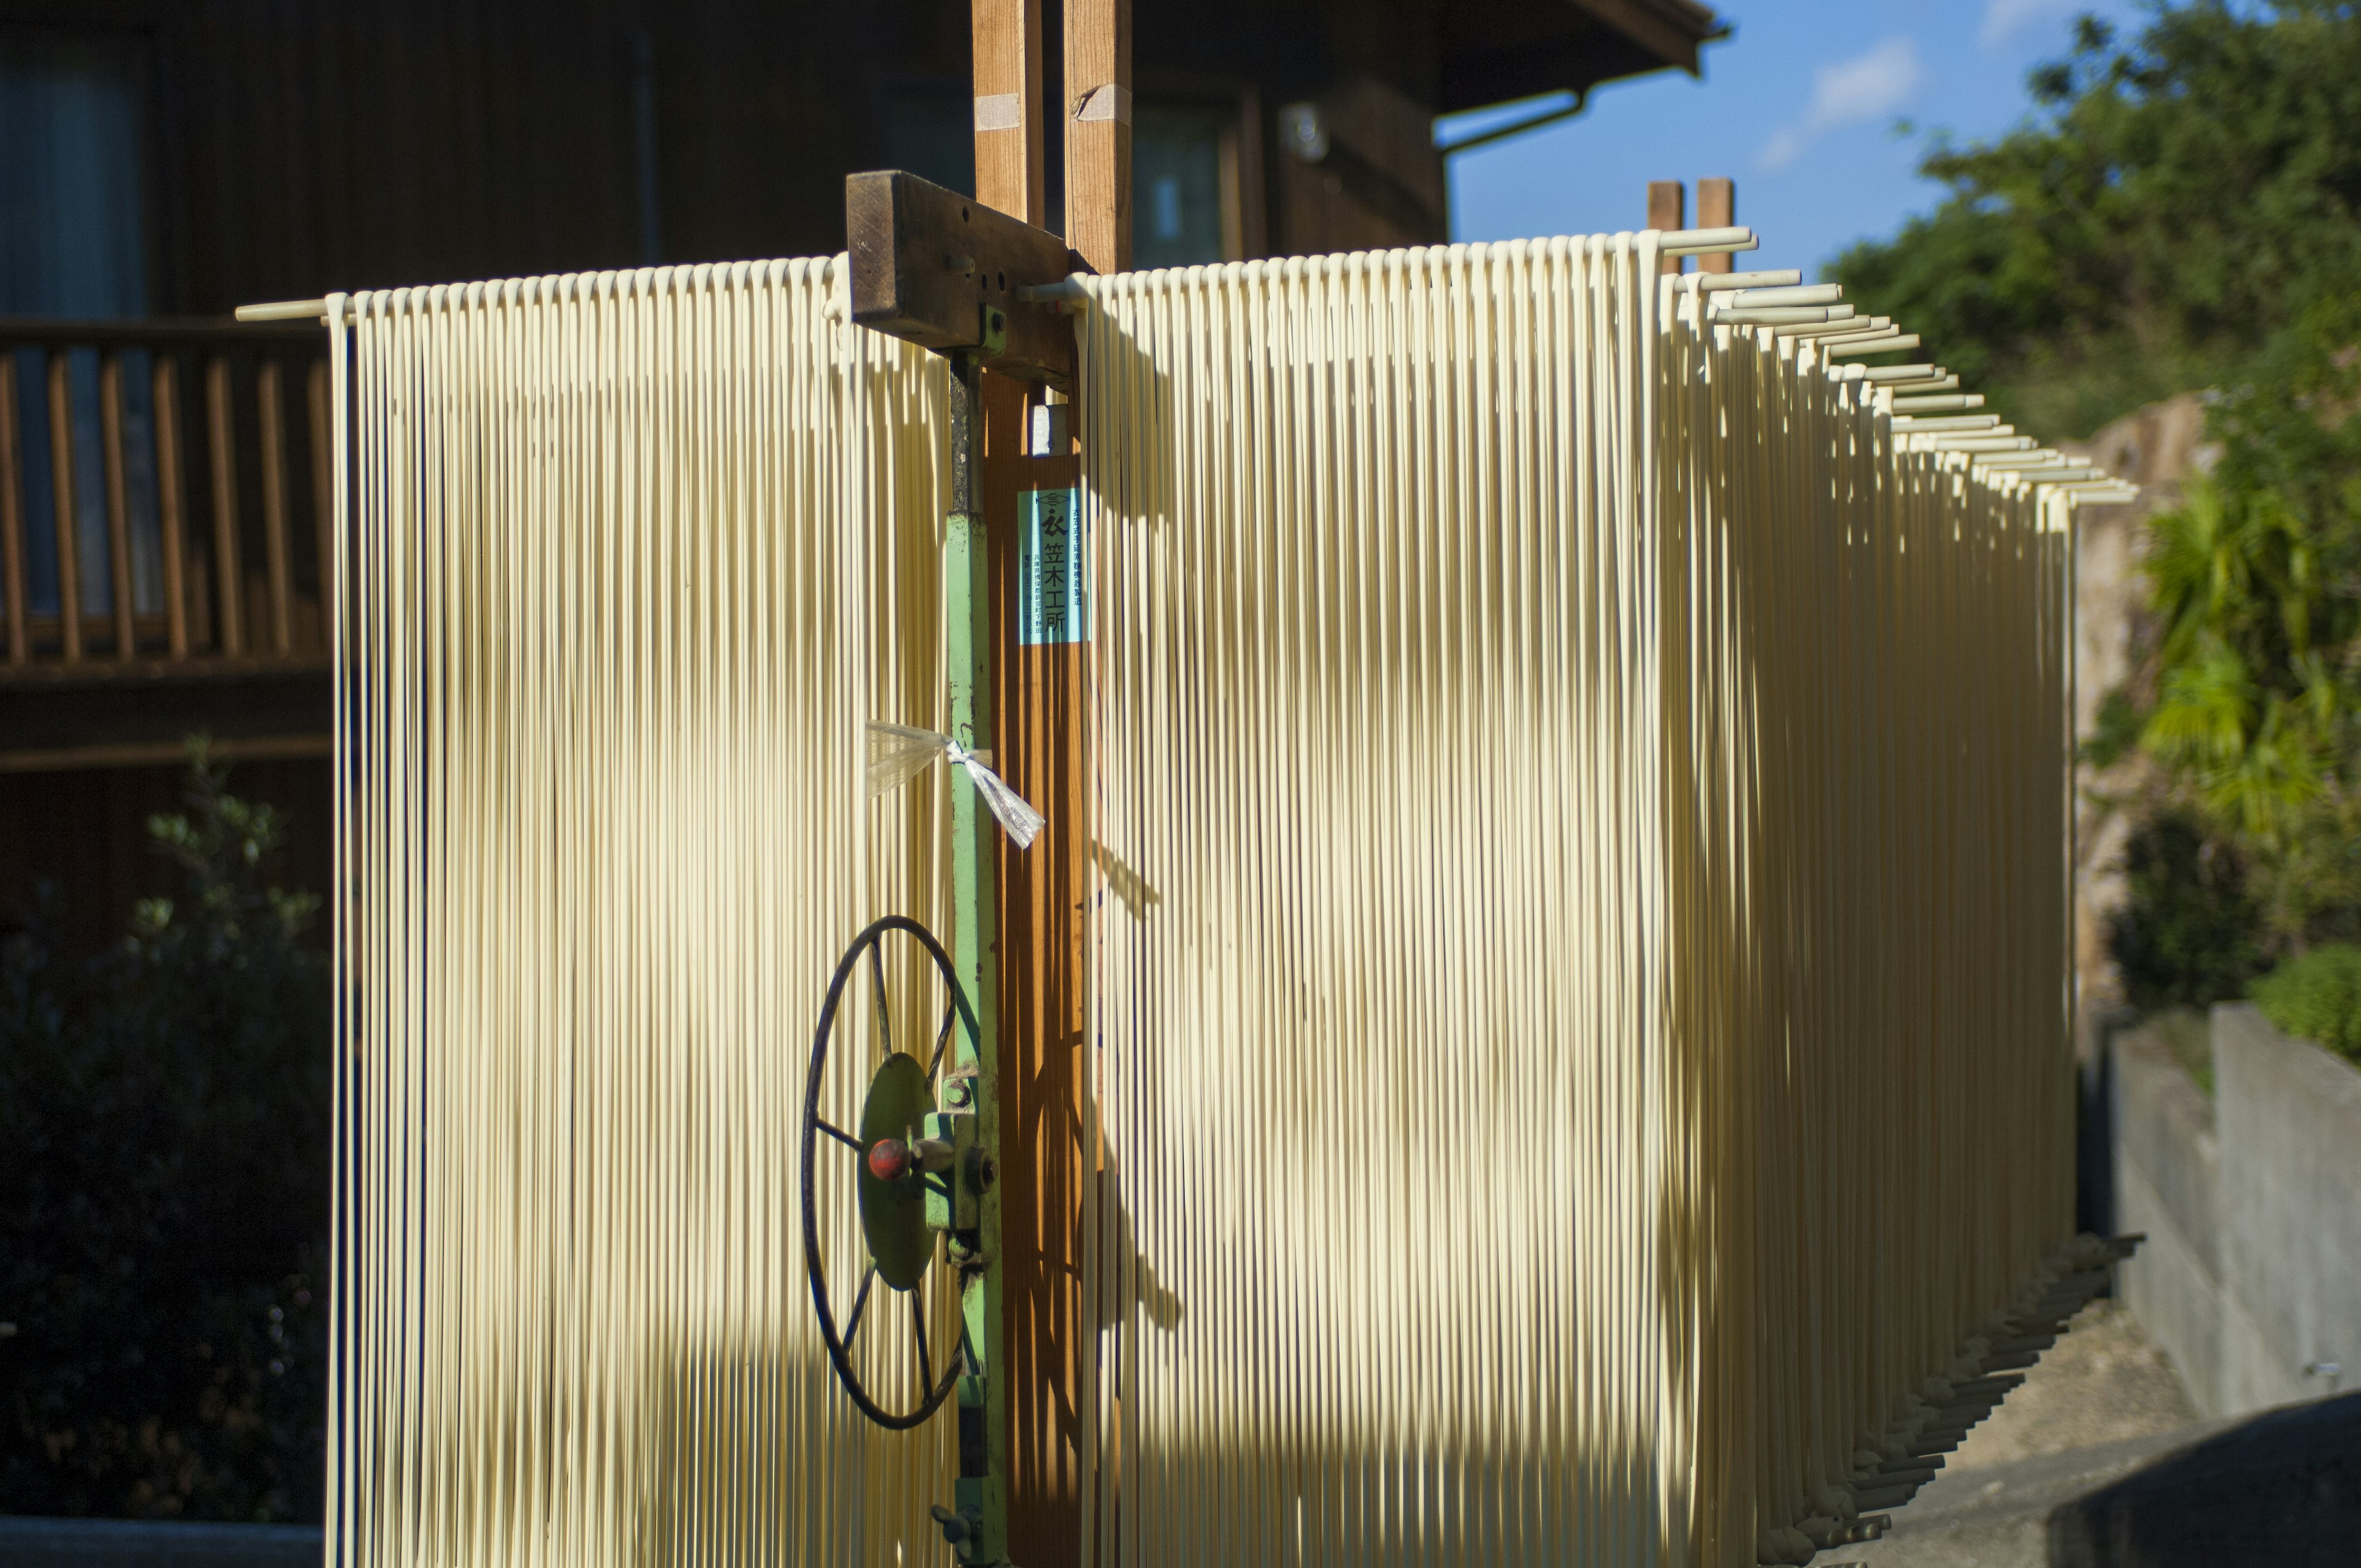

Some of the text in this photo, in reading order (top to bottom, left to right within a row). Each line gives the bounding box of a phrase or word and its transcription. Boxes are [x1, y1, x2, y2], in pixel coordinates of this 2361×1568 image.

[1040, 508, 1069, 633] 衣笠木工所
